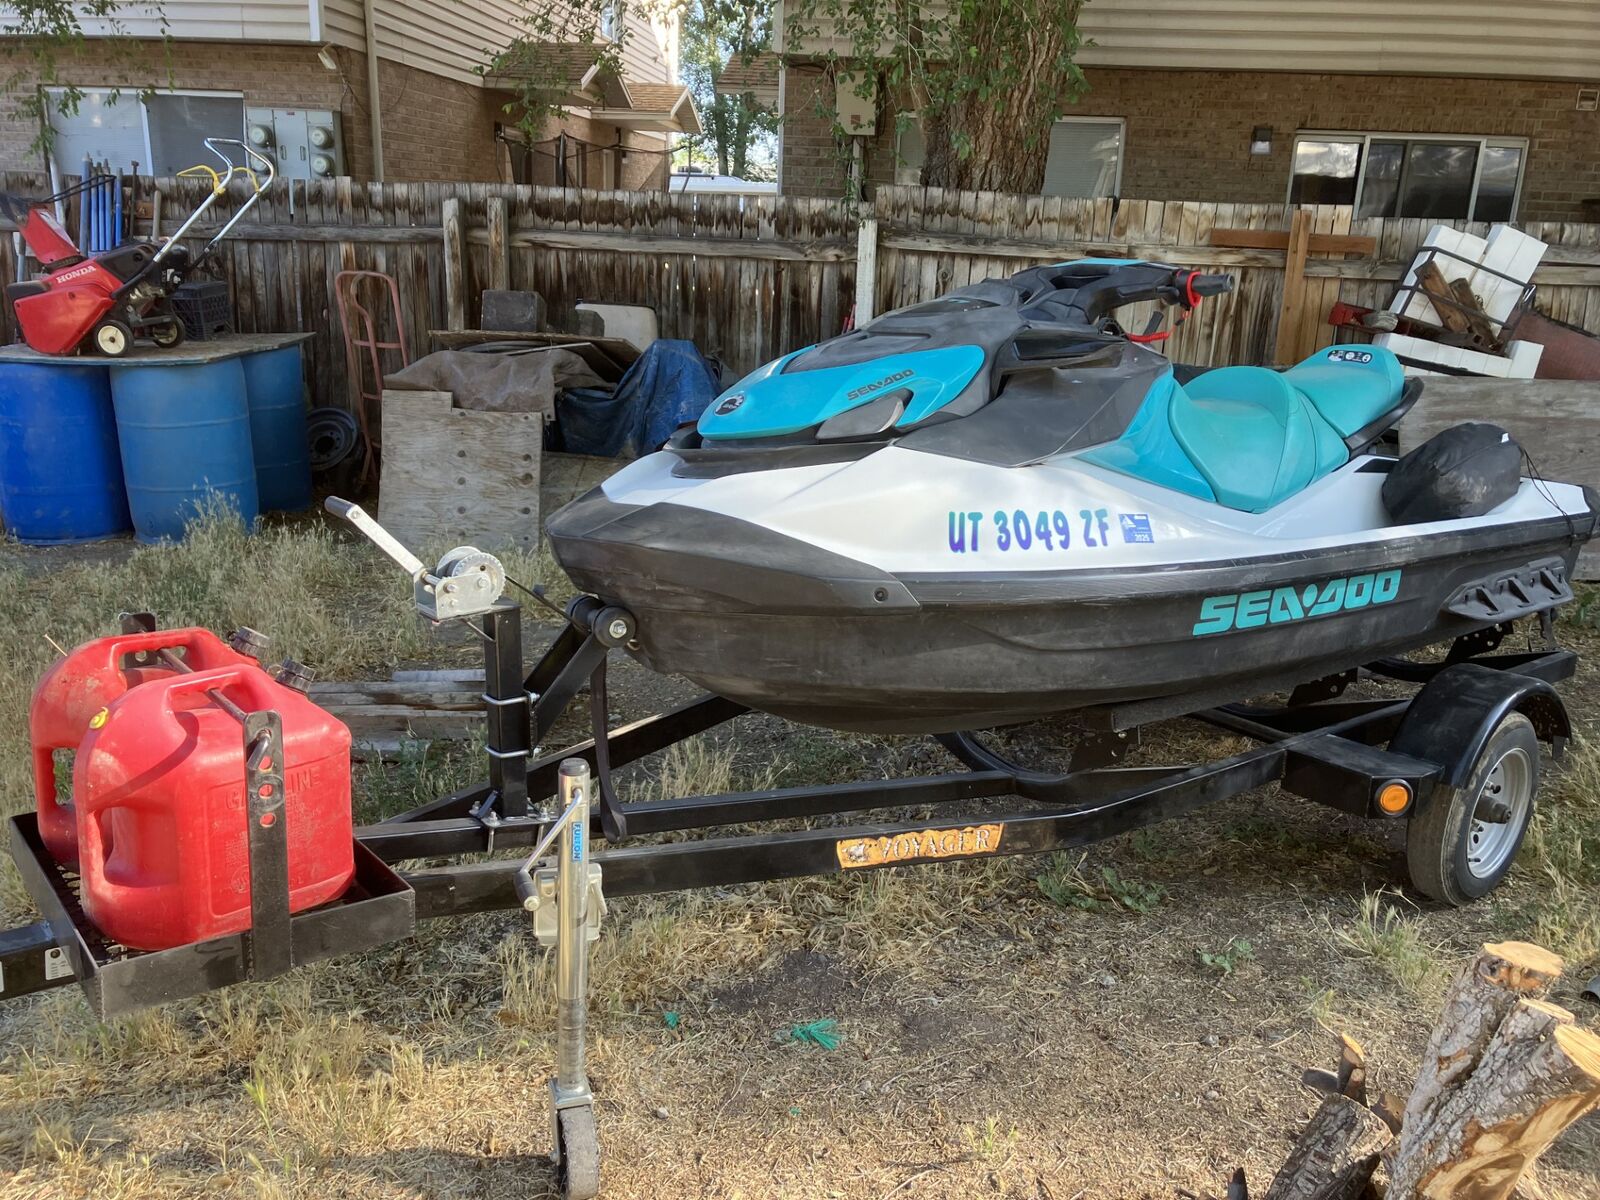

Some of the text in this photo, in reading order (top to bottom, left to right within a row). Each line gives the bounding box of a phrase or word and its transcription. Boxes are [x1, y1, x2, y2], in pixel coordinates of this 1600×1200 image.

[56, 265, 96, 284] HONDA
[948, 511, 984, 553] UT
[993, 508, 1071, 551] 3049
[226, 767, 320, 810] GAINE
[878, 829, 990, 861] VOYAGER
